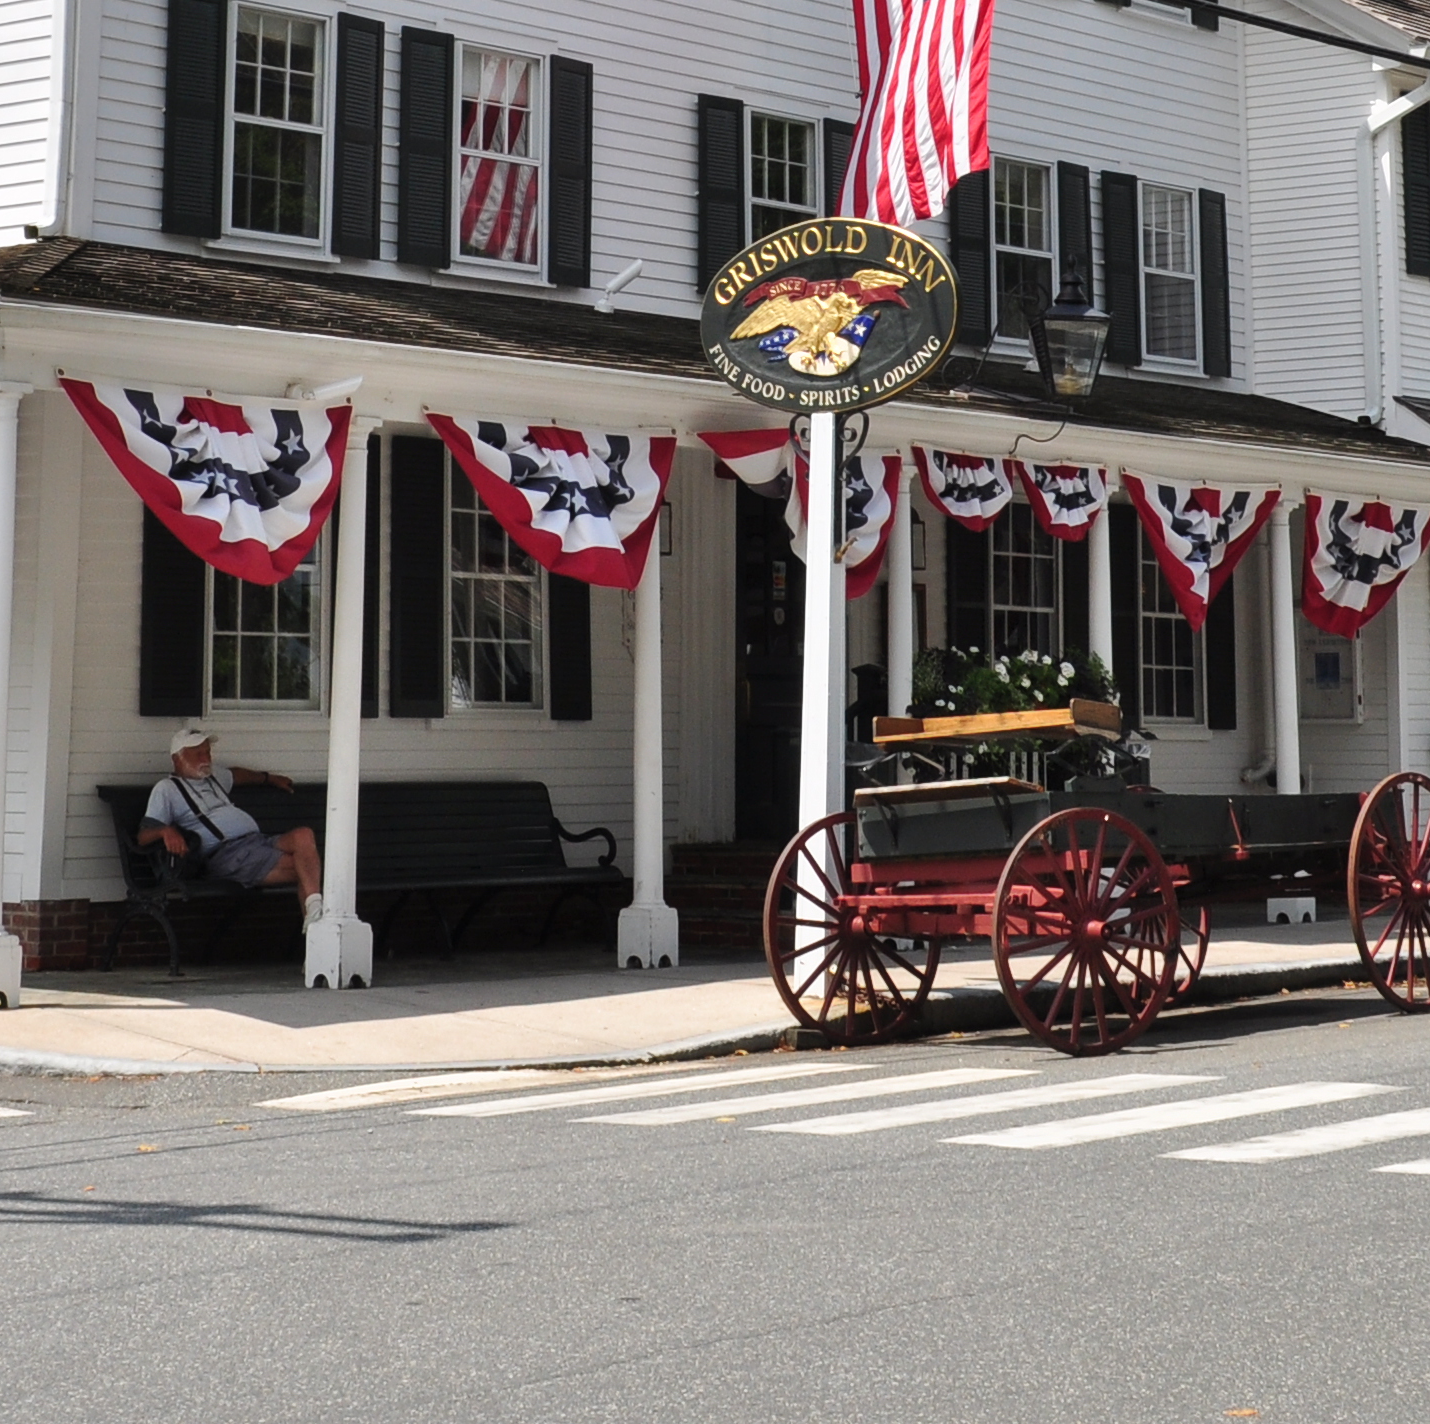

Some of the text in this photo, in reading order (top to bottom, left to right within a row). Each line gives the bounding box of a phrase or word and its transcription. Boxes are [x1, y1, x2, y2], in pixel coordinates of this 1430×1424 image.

[714, 225, 946, 305] GRISWOLD INN
[769, 280, 845, 297] SINCE 1776
[709, 335, 941, 407] FINE FOOD SPIRITS LODGING
